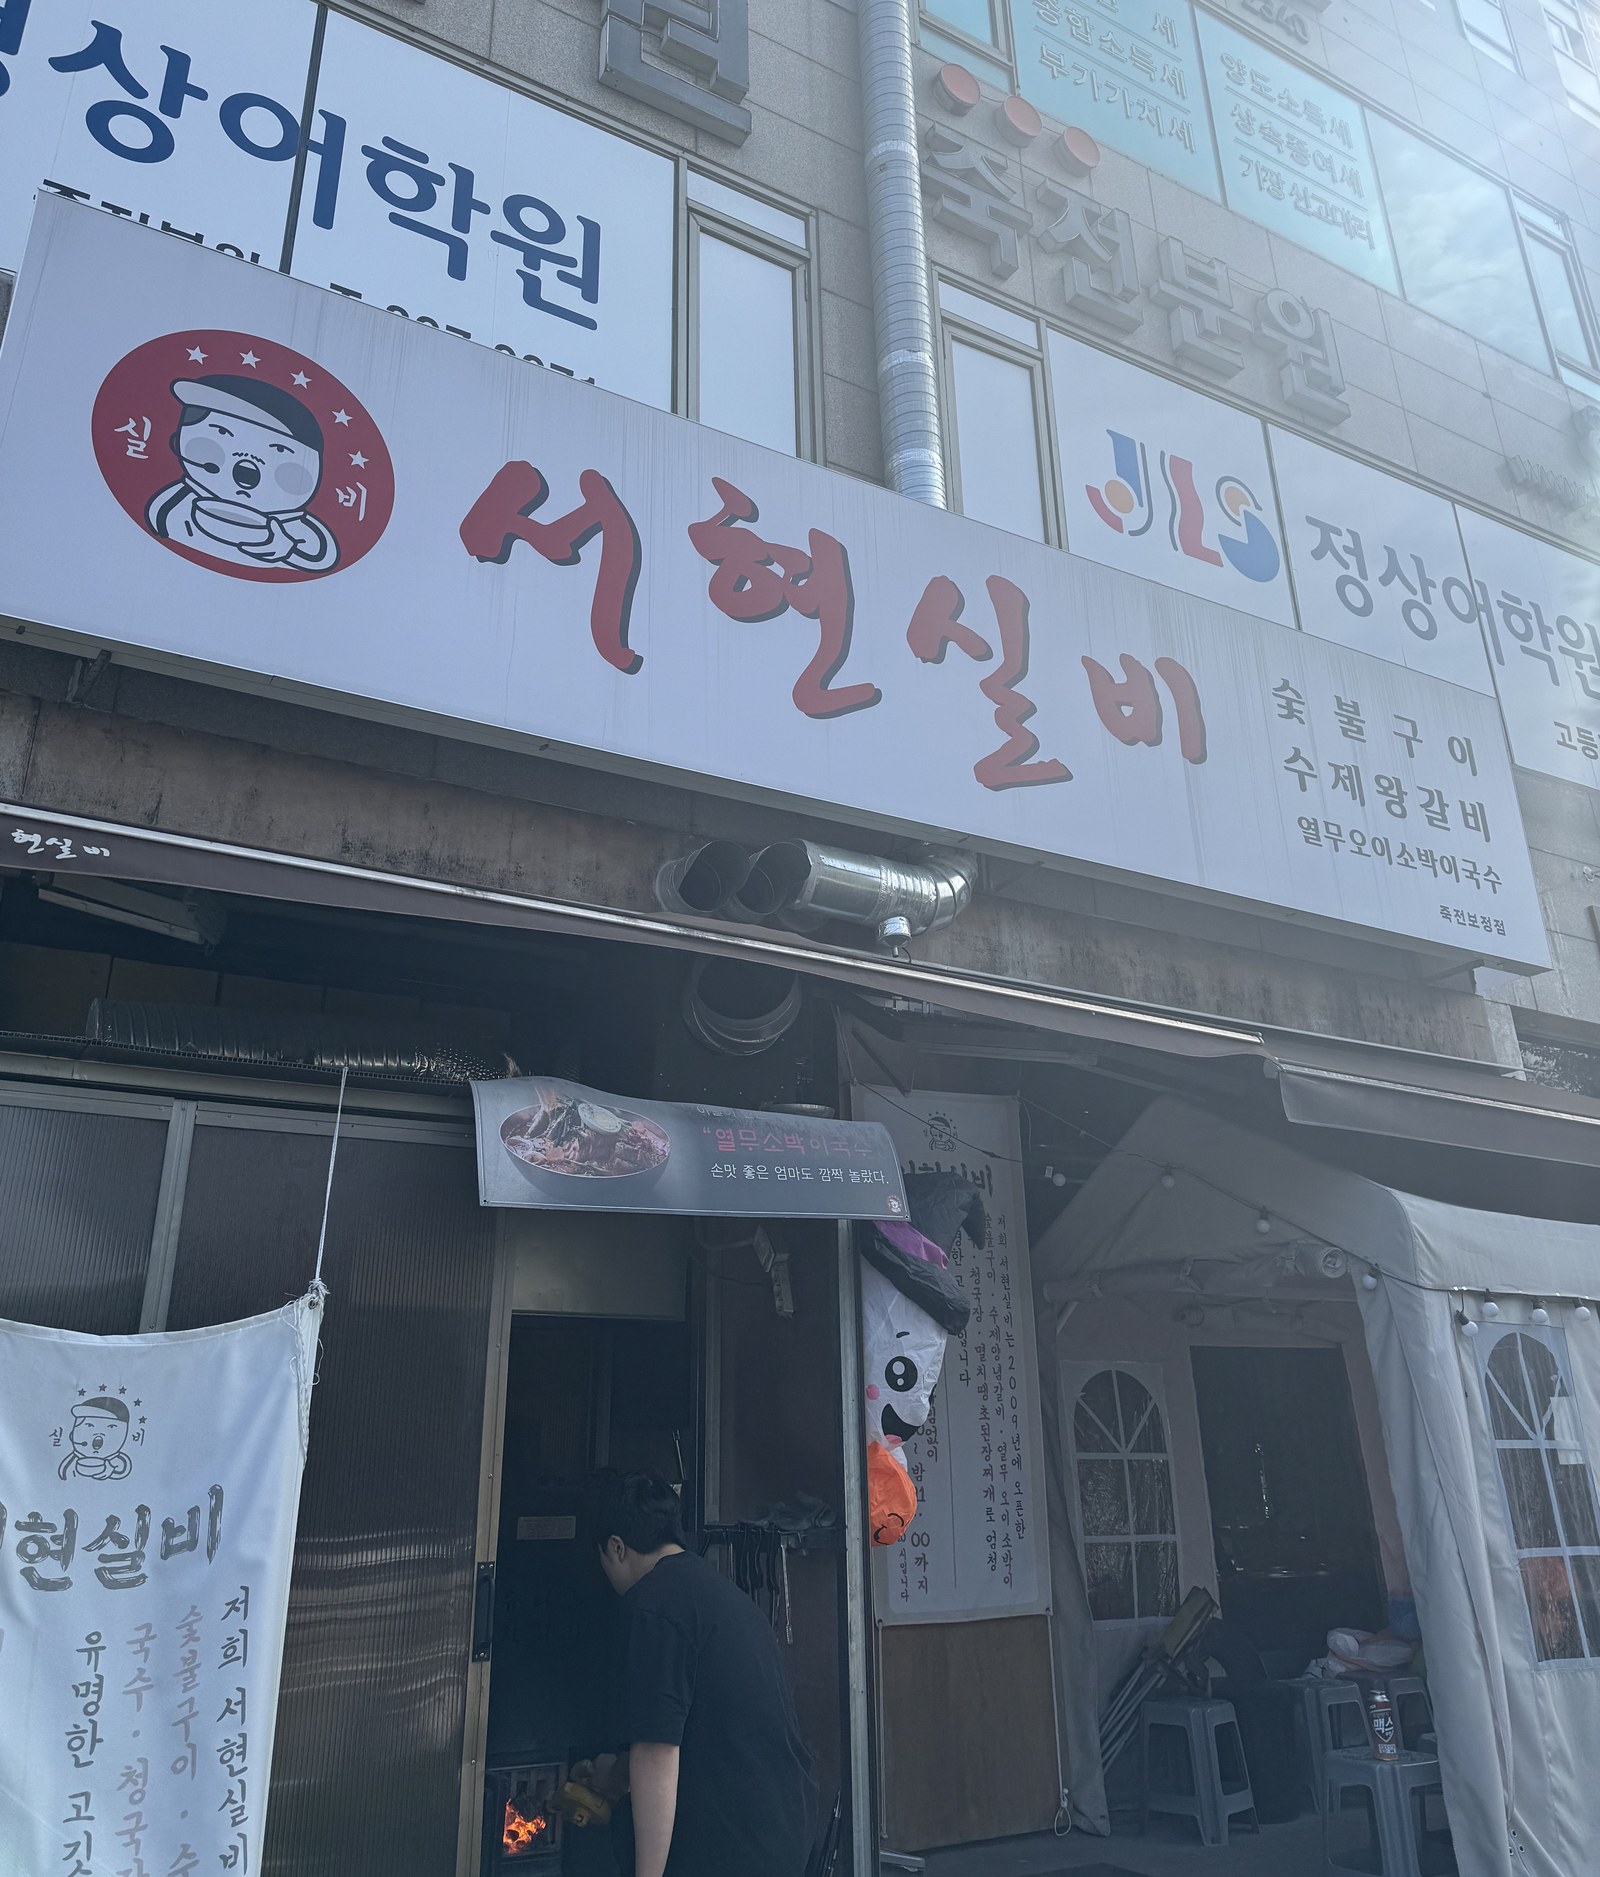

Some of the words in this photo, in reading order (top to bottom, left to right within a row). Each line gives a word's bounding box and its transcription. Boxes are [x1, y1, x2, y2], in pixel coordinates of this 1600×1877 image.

[1039, 43, 1197, 153] 부가가치세
[1221, 53, 1353, 150] 양도소득세
[0, 0, 601, 331] 상어학원
[1231, 103, 1364, 199] 상속증여세
[114, 416, 152, 460] 실
[1085, 429, 1281, 583] JLS
[459, 459, 1208, 792] 서현실비
[1283, 746, 1491, 844] 수제왕갈비
[1296, 815, 1503, 894] 열무오이소박이국수
[1439, 904, 1507, 937] 죽전보정점
[710, 1163, 738, 1181] 손맛
[743, 1164, 770, 1181] 좋은
[774, 1165, 815, 1182] 엄마도
[819, 1167, 844, 1183] 깜짝
[848, 1168, 891, 1186] 놀랐다.
[0, 1484, 225, 1593] 현실비
[122, 1622, 158, 1713] 국수
[217, 1585, 250, 1670] 저희
[65, 1630, 108, 1769] 유명한
[170, 1605, 204, 1781] 숯불구이
[216, 1687, 249, 1877] 서현실비
